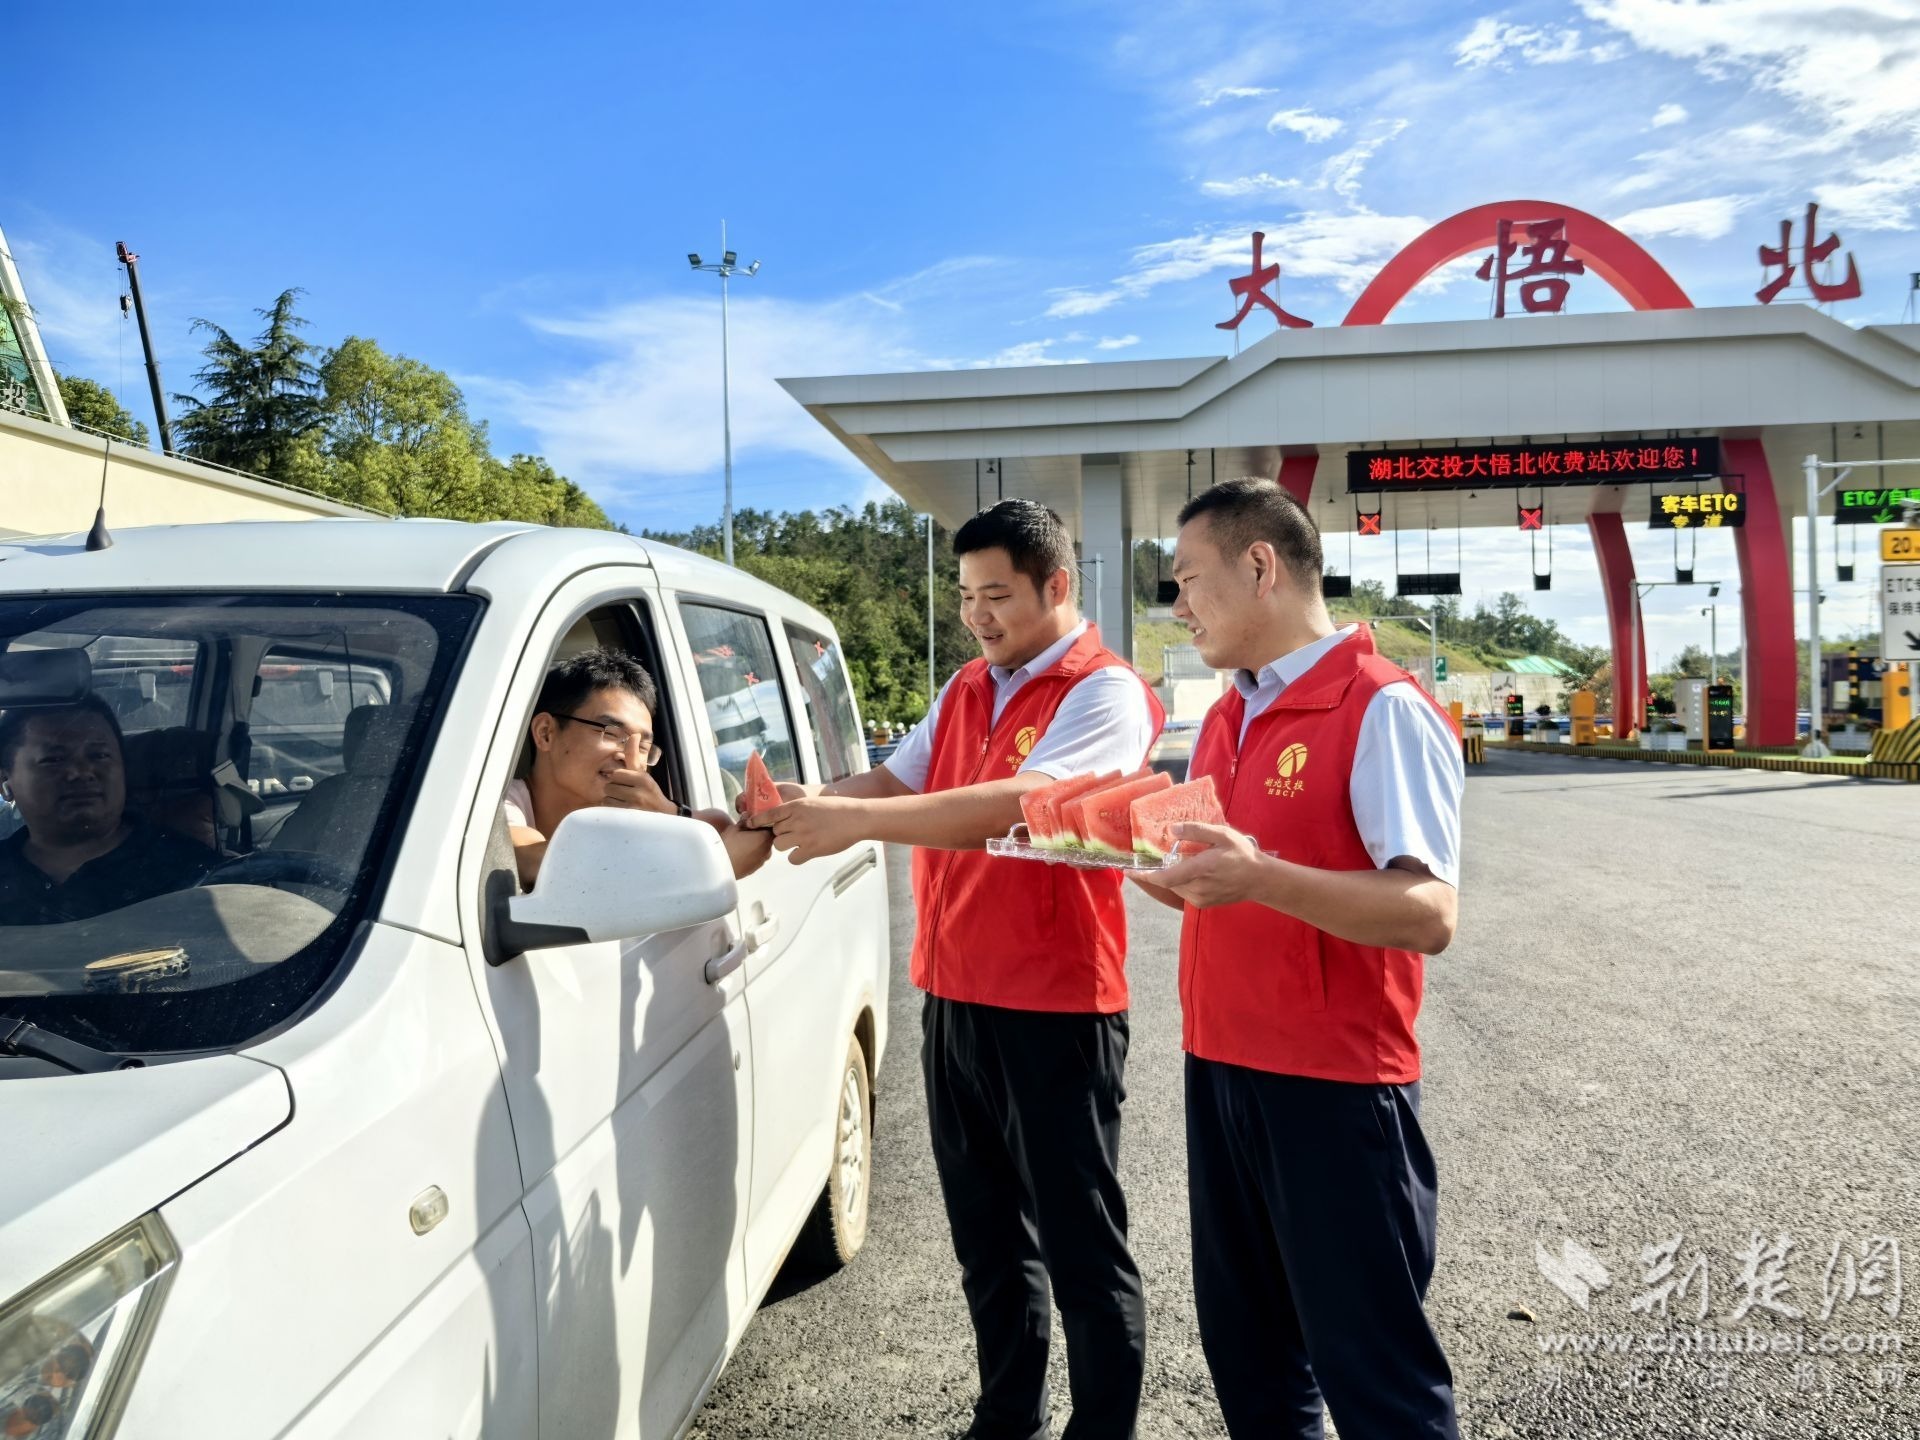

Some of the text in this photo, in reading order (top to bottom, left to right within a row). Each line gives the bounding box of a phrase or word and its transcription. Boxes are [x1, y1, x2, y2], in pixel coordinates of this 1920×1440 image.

[1215, 203, 1861, 330] 大悟北
[1264, 777, 1304, 791] 湖北交投
[1268, 788, 1295, 798] HBCI
